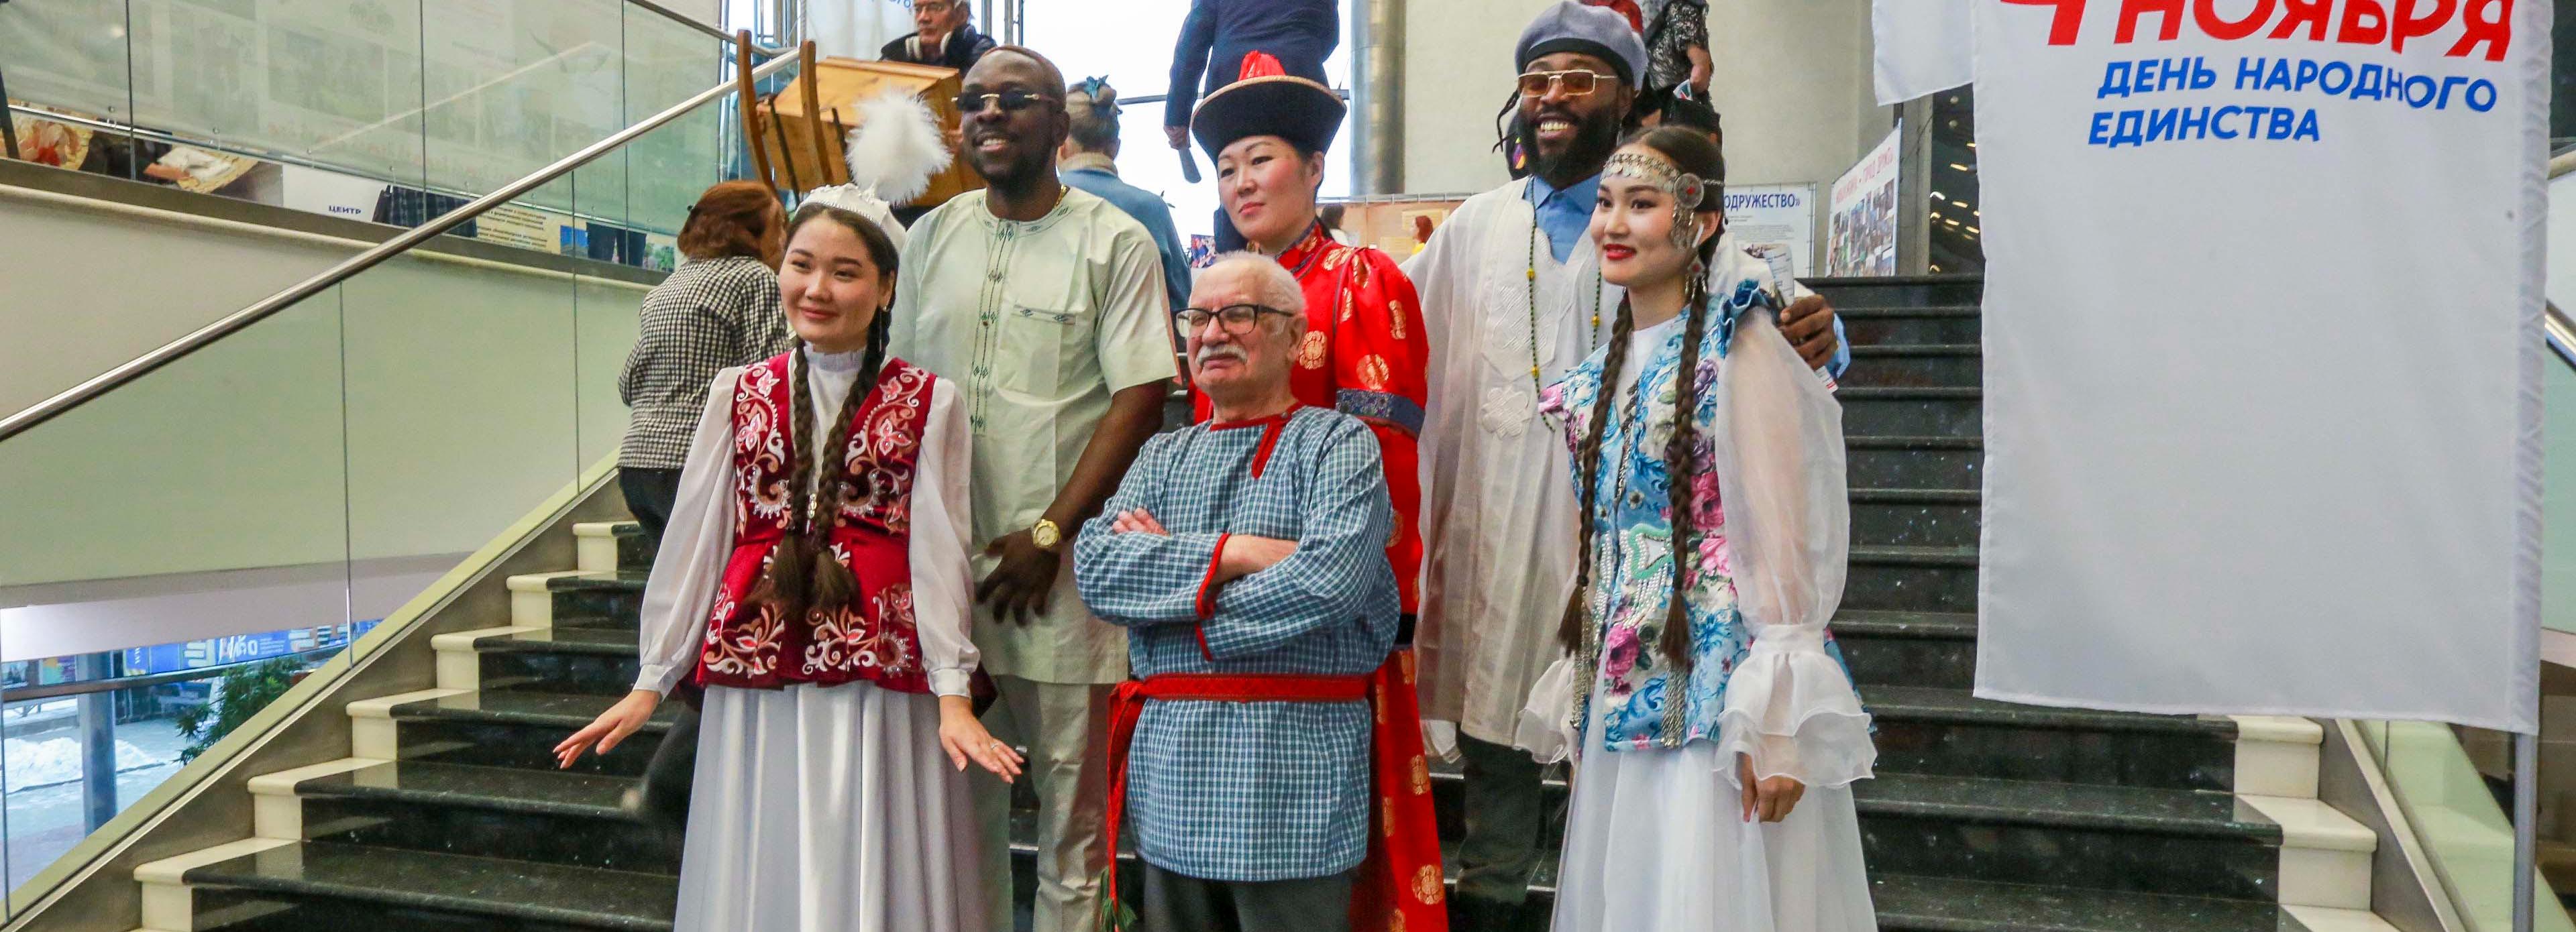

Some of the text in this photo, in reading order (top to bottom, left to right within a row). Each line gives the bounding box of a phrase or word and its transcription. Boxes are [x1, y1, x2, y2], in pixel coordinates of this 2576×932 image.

[2114, 0, 2514, 62] НОЯБРЯ
[2097, 56, 2496, 112] ДЕНЬ НАРОДНОГО
[2088, 105, 2320, 148] ЕДИНСТВА
[329, 205, 362, 214] ЦЕНТР
[1724, 193, 1801, 211] ОДРУЖЕСТВО»
